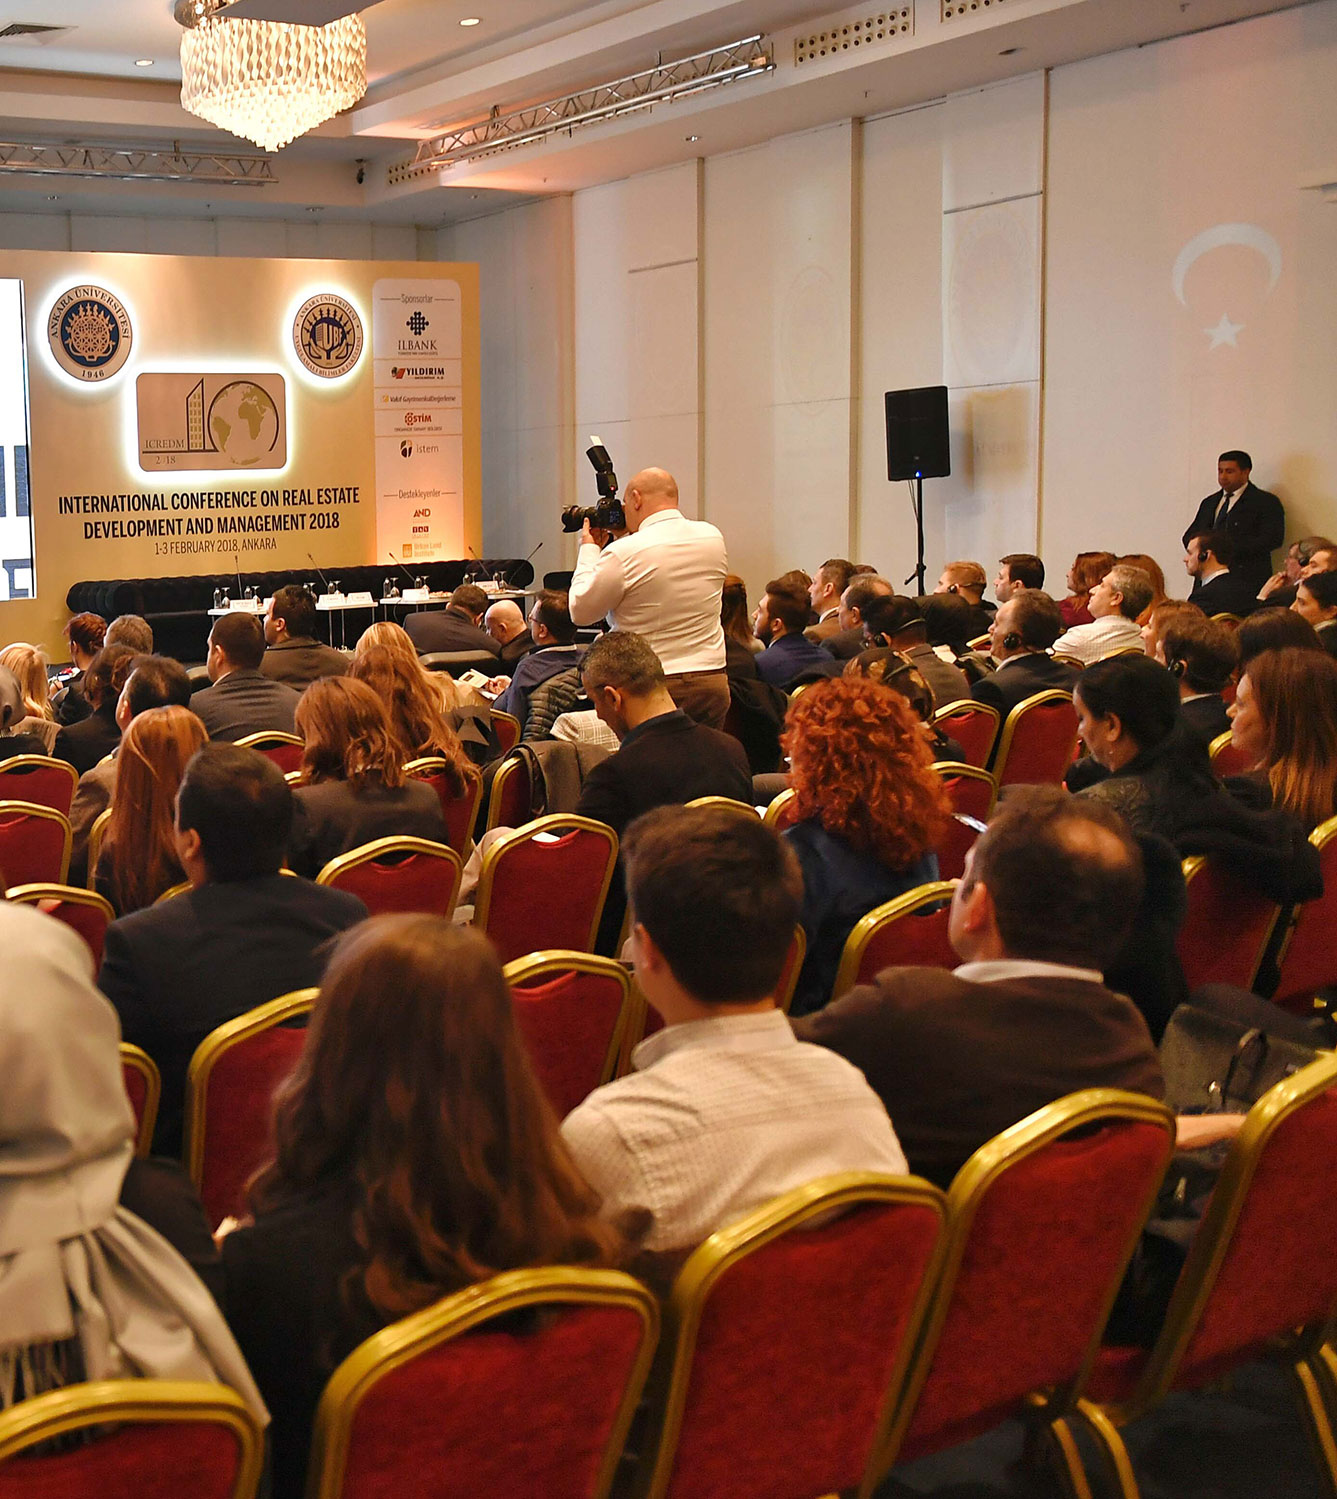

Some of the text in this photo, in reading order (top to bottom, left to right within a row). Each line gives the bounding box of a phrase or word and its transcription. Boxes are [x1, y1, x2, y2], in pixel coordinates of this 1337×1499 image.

[51, 294, 74, 338] ANKARA
[82, 369, 104, 378] 1946
[406, 367, 445, 375] YILDIRIM
[145, 439, 185, 449] ICREDM
[416, 444, 439, 454] istem
[58, 487, 360, 514] INTERNATIONAL CONFERENCE ON REAL ESTATE
[84, 512, 340, 539] DEVELOPMENT AND MANAGEMENT 2018
[155, 542, 167, 555] 1-3
[170, 540, 215, 554] FEBRUARY
[241, 537, 277, 551] ANKARA
